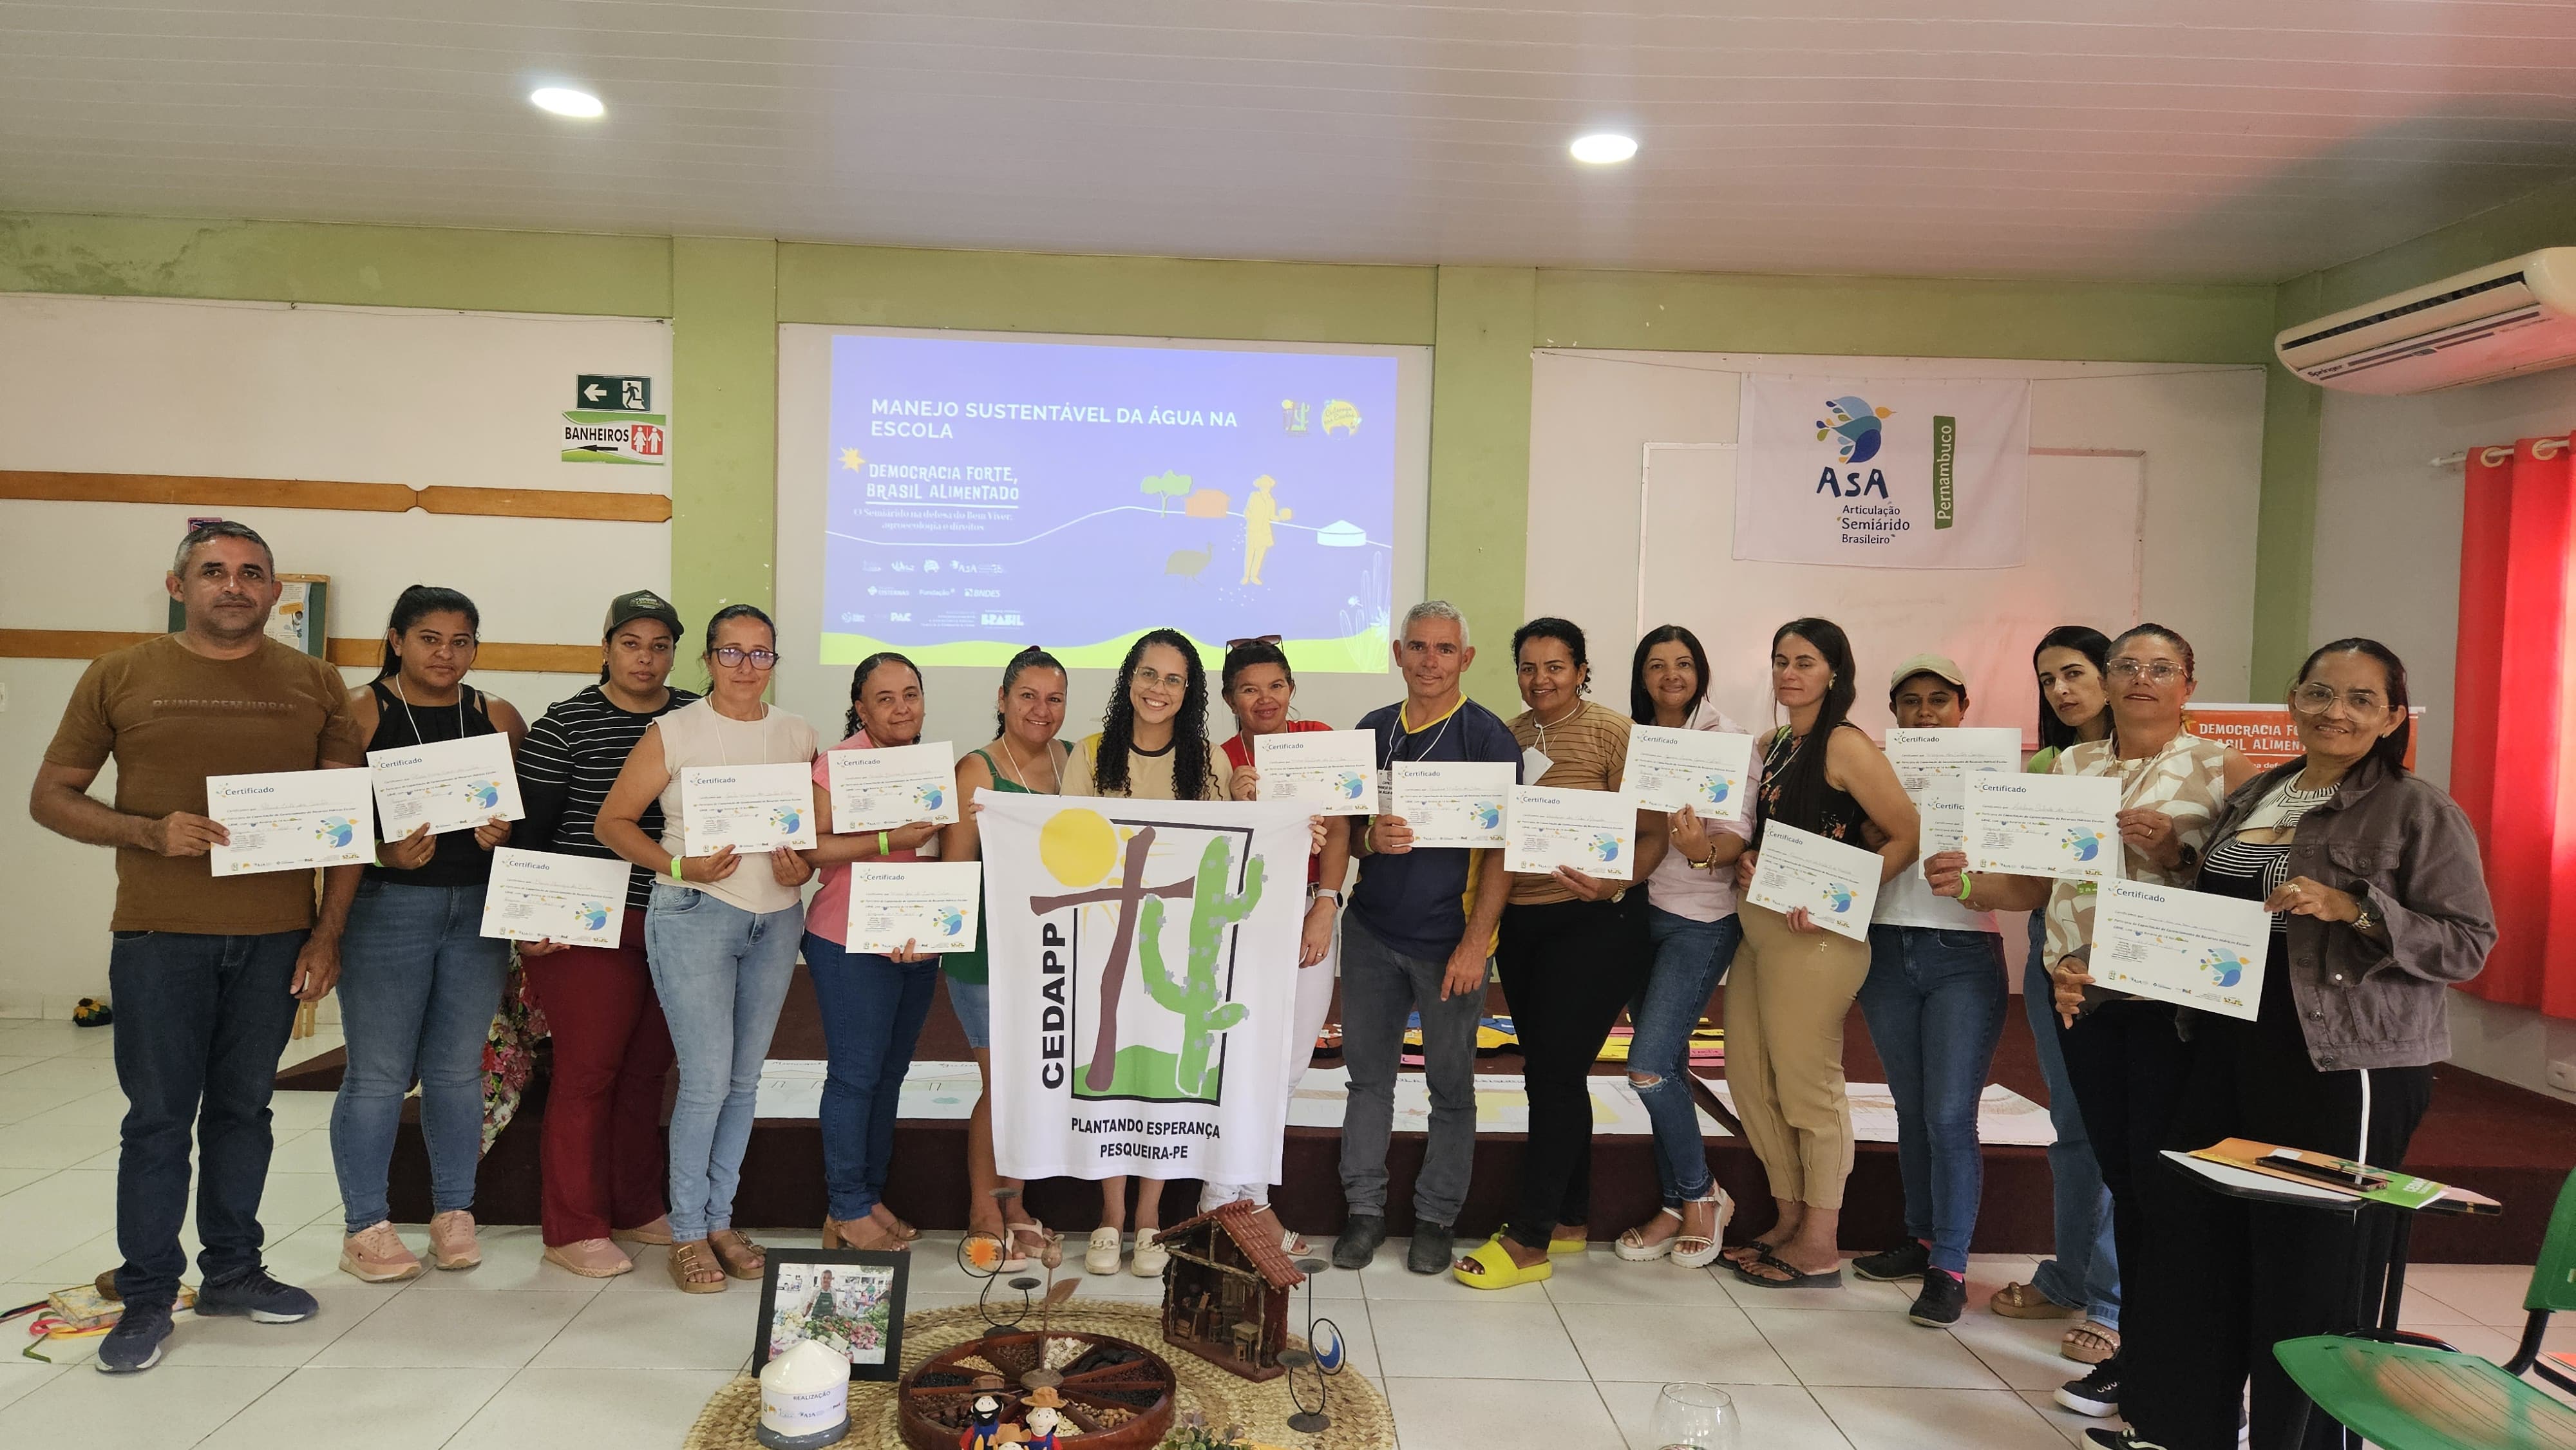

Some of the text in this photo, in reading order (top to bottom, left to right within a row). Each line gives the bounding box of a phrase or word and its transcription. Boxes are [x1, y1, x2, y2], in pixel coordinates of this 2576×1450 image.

[871, 399, 1237, 427] MANEJO SUSTENTÁVEL DA ÁGUA NA
[565, 427, 629, 442] BANHEIROS
[871, 420, 953, 438] ESCOLA
[869, 463, 1018, 484] DEMOCRACIA FORTE,
[1937, 425, 1953, 520] Pernambuco
[866, 483, 1019, 500] BRASIL ALIMENTADO
[1842, 505, 1900, 517] Articulação
[1842, 518, 1910, 531] Semiárido
[1842, 534, 1890, 544] Brasileiro
[920, 588, 950, 597] Fundação
[974, 589, 1000, 598] BNDES
[2199, 723, 2282, 737] DEMOCRACIA
[1643, 735, 1678, 745] Certificado
[2253, 739, 2307, 751] ALIMEN
[381, 757, 422, 769] Certificado
[225, 786, 274, 796] Certificado
[1982, 784, 2027, 793] Certificado
[1523, 796, 1560, 805] Certificado
[1769, 831, 1803, 845] Certificado
[509, 860, 550, 871] Certificado
[2116, 887, 2165, 903] Certificado
[1041, 923, 1066, 1089] CEDAPP
[1072, 1118, 1220, 1138] PLANTANDO ESPERANÇA
[1100, 1143, 1189, 1160] PESQUEIRA-PE
[793, 1391, 831, 1401] REALIZAÇÃO
